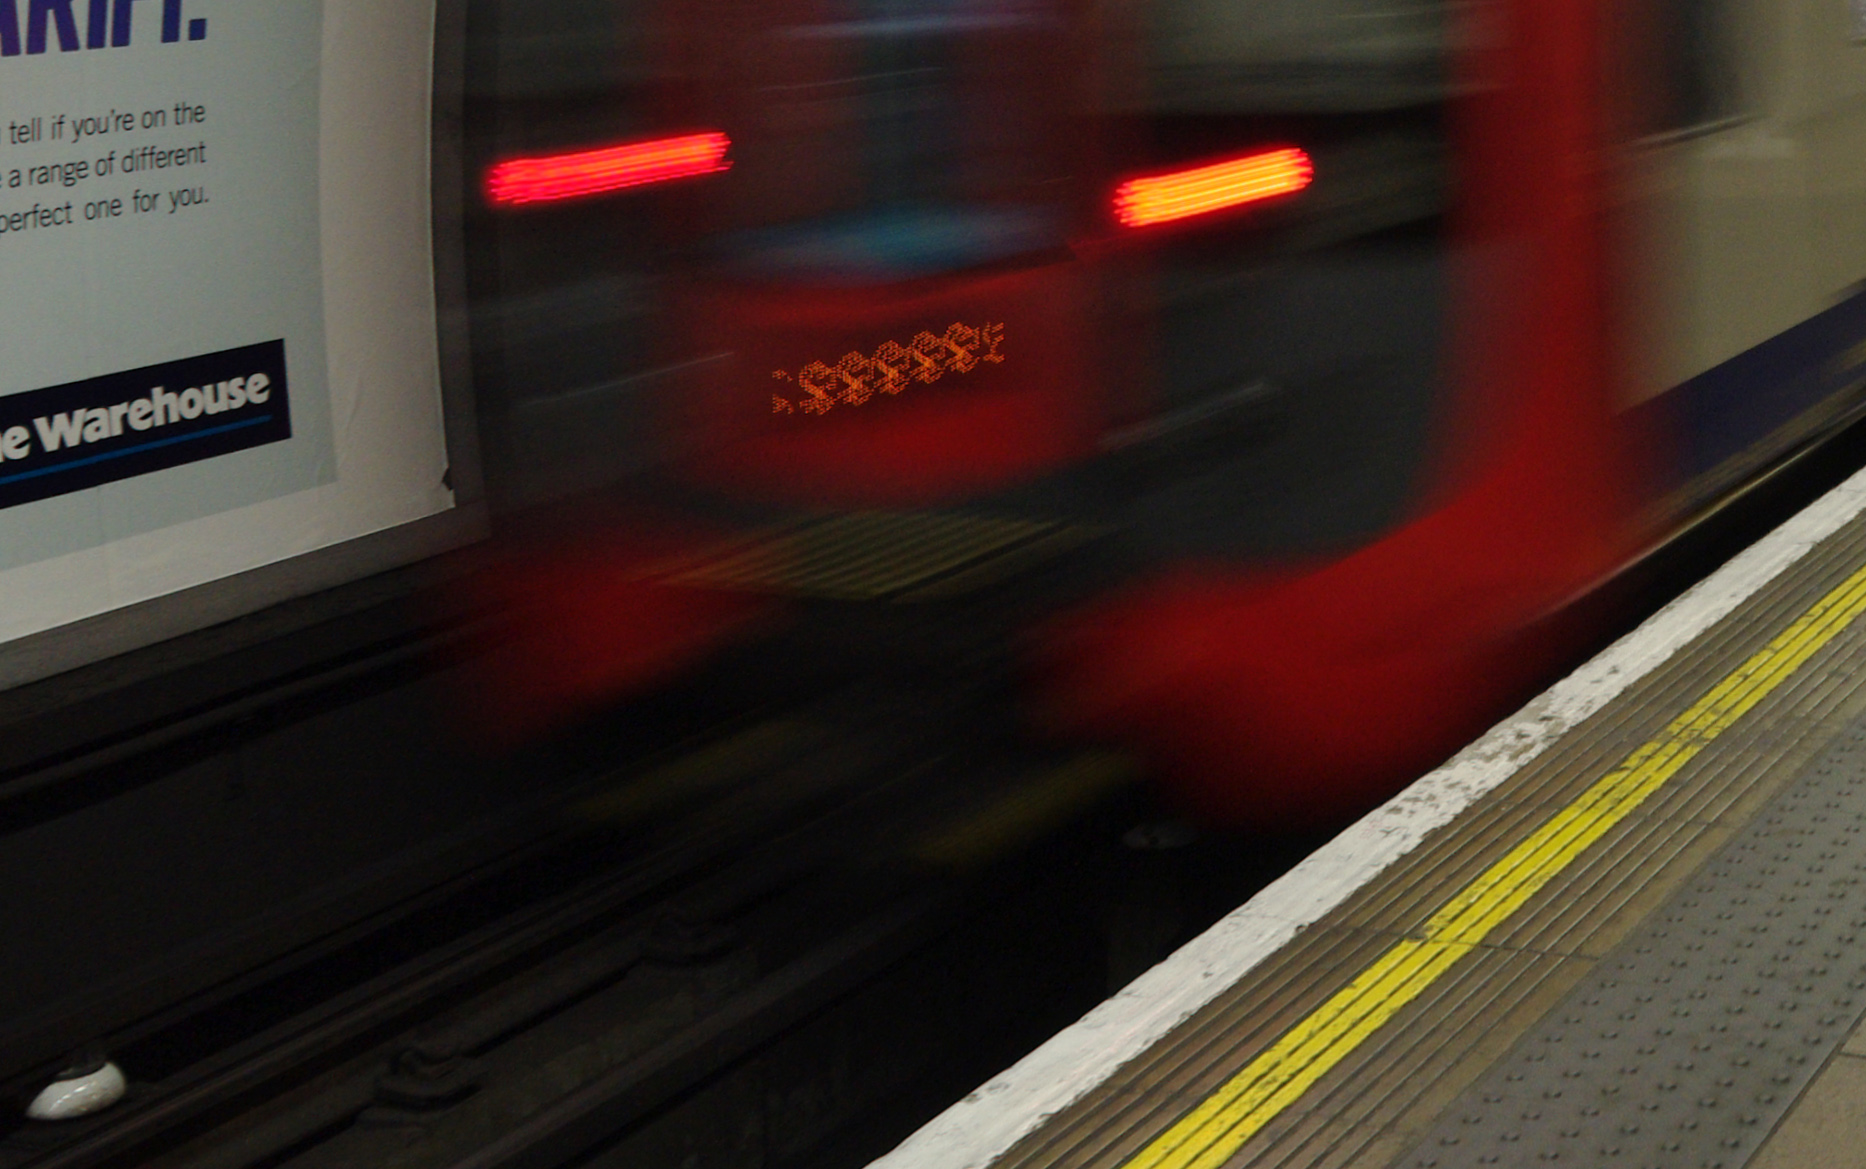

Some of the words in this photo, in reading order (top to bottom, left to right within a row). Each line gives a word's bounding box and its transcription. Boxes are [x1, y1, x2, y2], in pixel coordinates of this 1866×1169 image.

[9, 117, 42, 144] tell
[51, 115, 66, 140] if
[141, 109, 166, 130] on
[174, 102, 206, 126] the
[9, 169, 21, 188] a
[29, 160, 89, 187] range
[95, 151, 115, 177] of
[121, 141, 207, 174] different
[84, 198, 123, 221] one
[132, 189, 160, 214] for
[168, 186, 209, 214] you.
[0, 426, 31, 463] e
[33, 372, 271, 452] Warehouse
